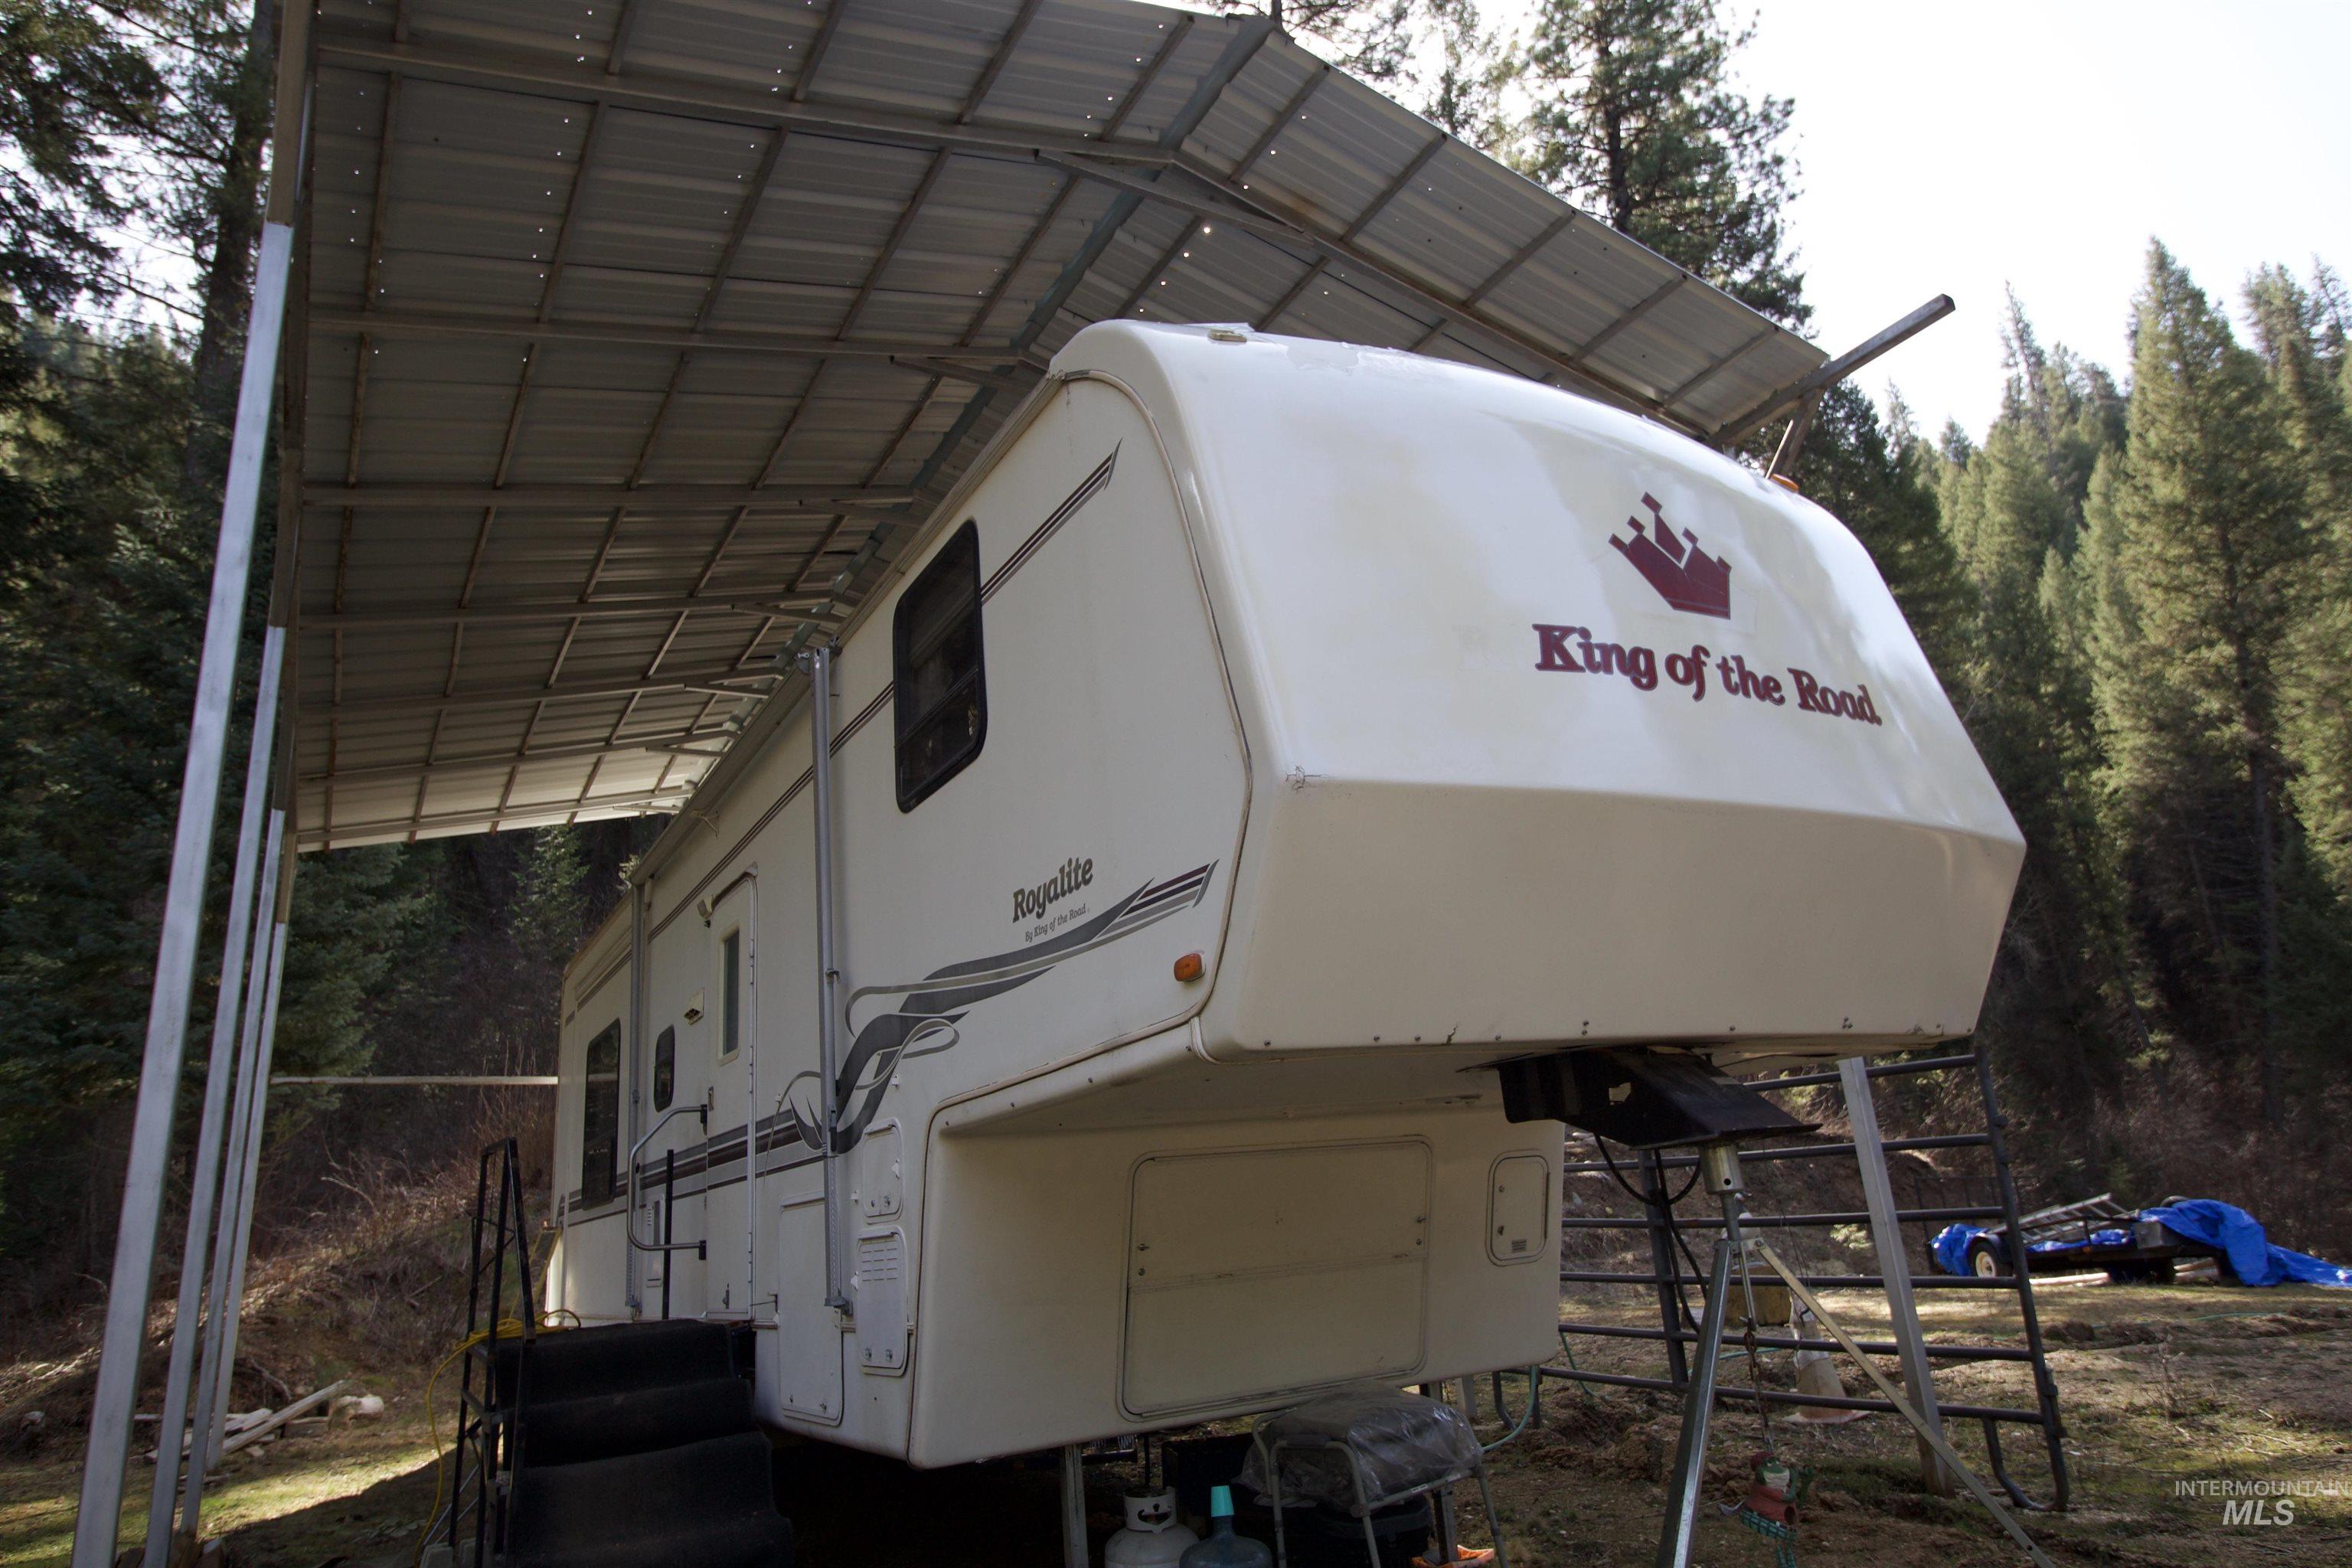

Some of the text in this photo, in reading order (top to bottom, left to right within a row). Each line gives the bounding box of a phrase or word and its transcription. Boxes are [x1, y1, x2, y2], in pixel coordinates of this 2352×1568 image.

[1531, 623, 1658, 691] King
[1664, 645, 1711, 701] of
[1716, 655, 1786, 706] the
[1012, 858, 1093, 923] Royalite
[1034, 924, 1048, 937] King
[1049, 917, 1057, 932] of
[1057, 914, 1068, 926] the
[1069, 903, 1086, 920] Road
